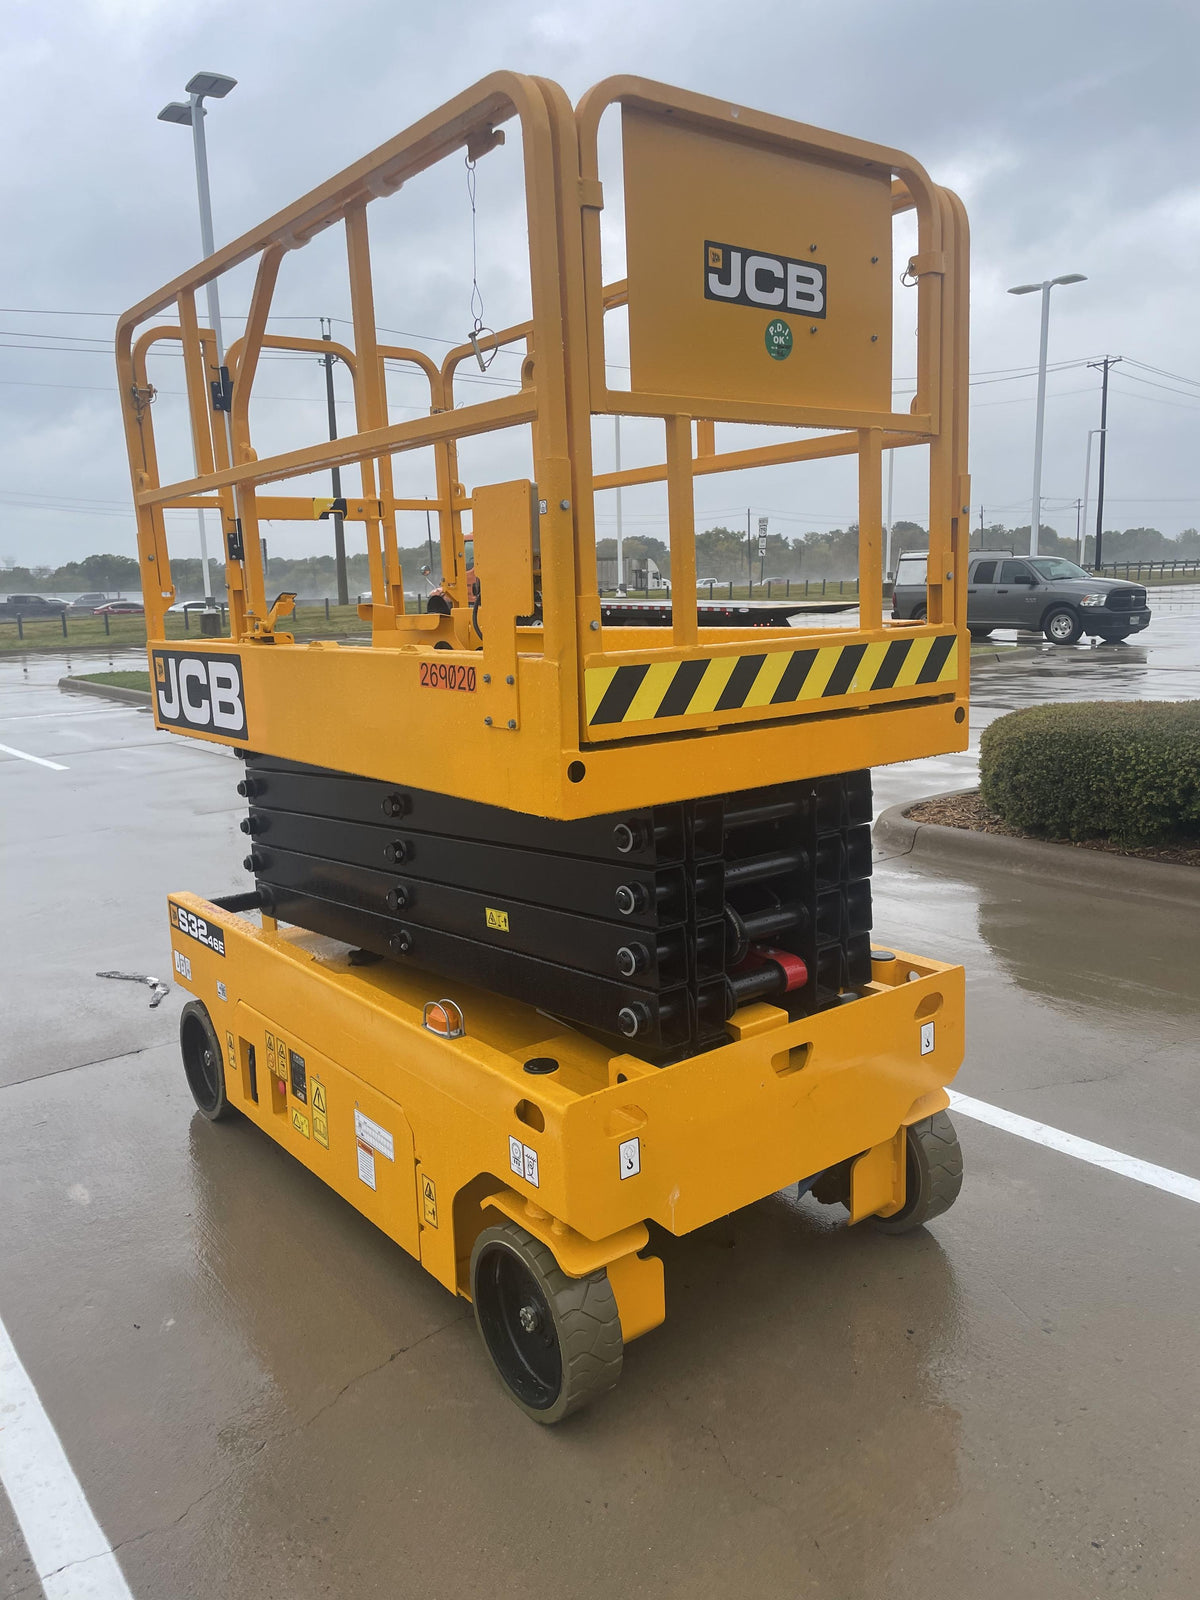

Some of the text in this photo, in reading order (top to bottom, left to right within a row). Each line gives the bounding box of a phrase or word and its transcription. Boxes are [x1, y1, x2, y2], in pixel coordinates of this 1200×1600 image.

[708, 251, 824, 313] JCB
[768, 323, 790, 340] P.D.I.
[773, 336, 785, 345] OK
[420, 662, 476, 692] 269020
[158, 657, 244, 731] JCB
